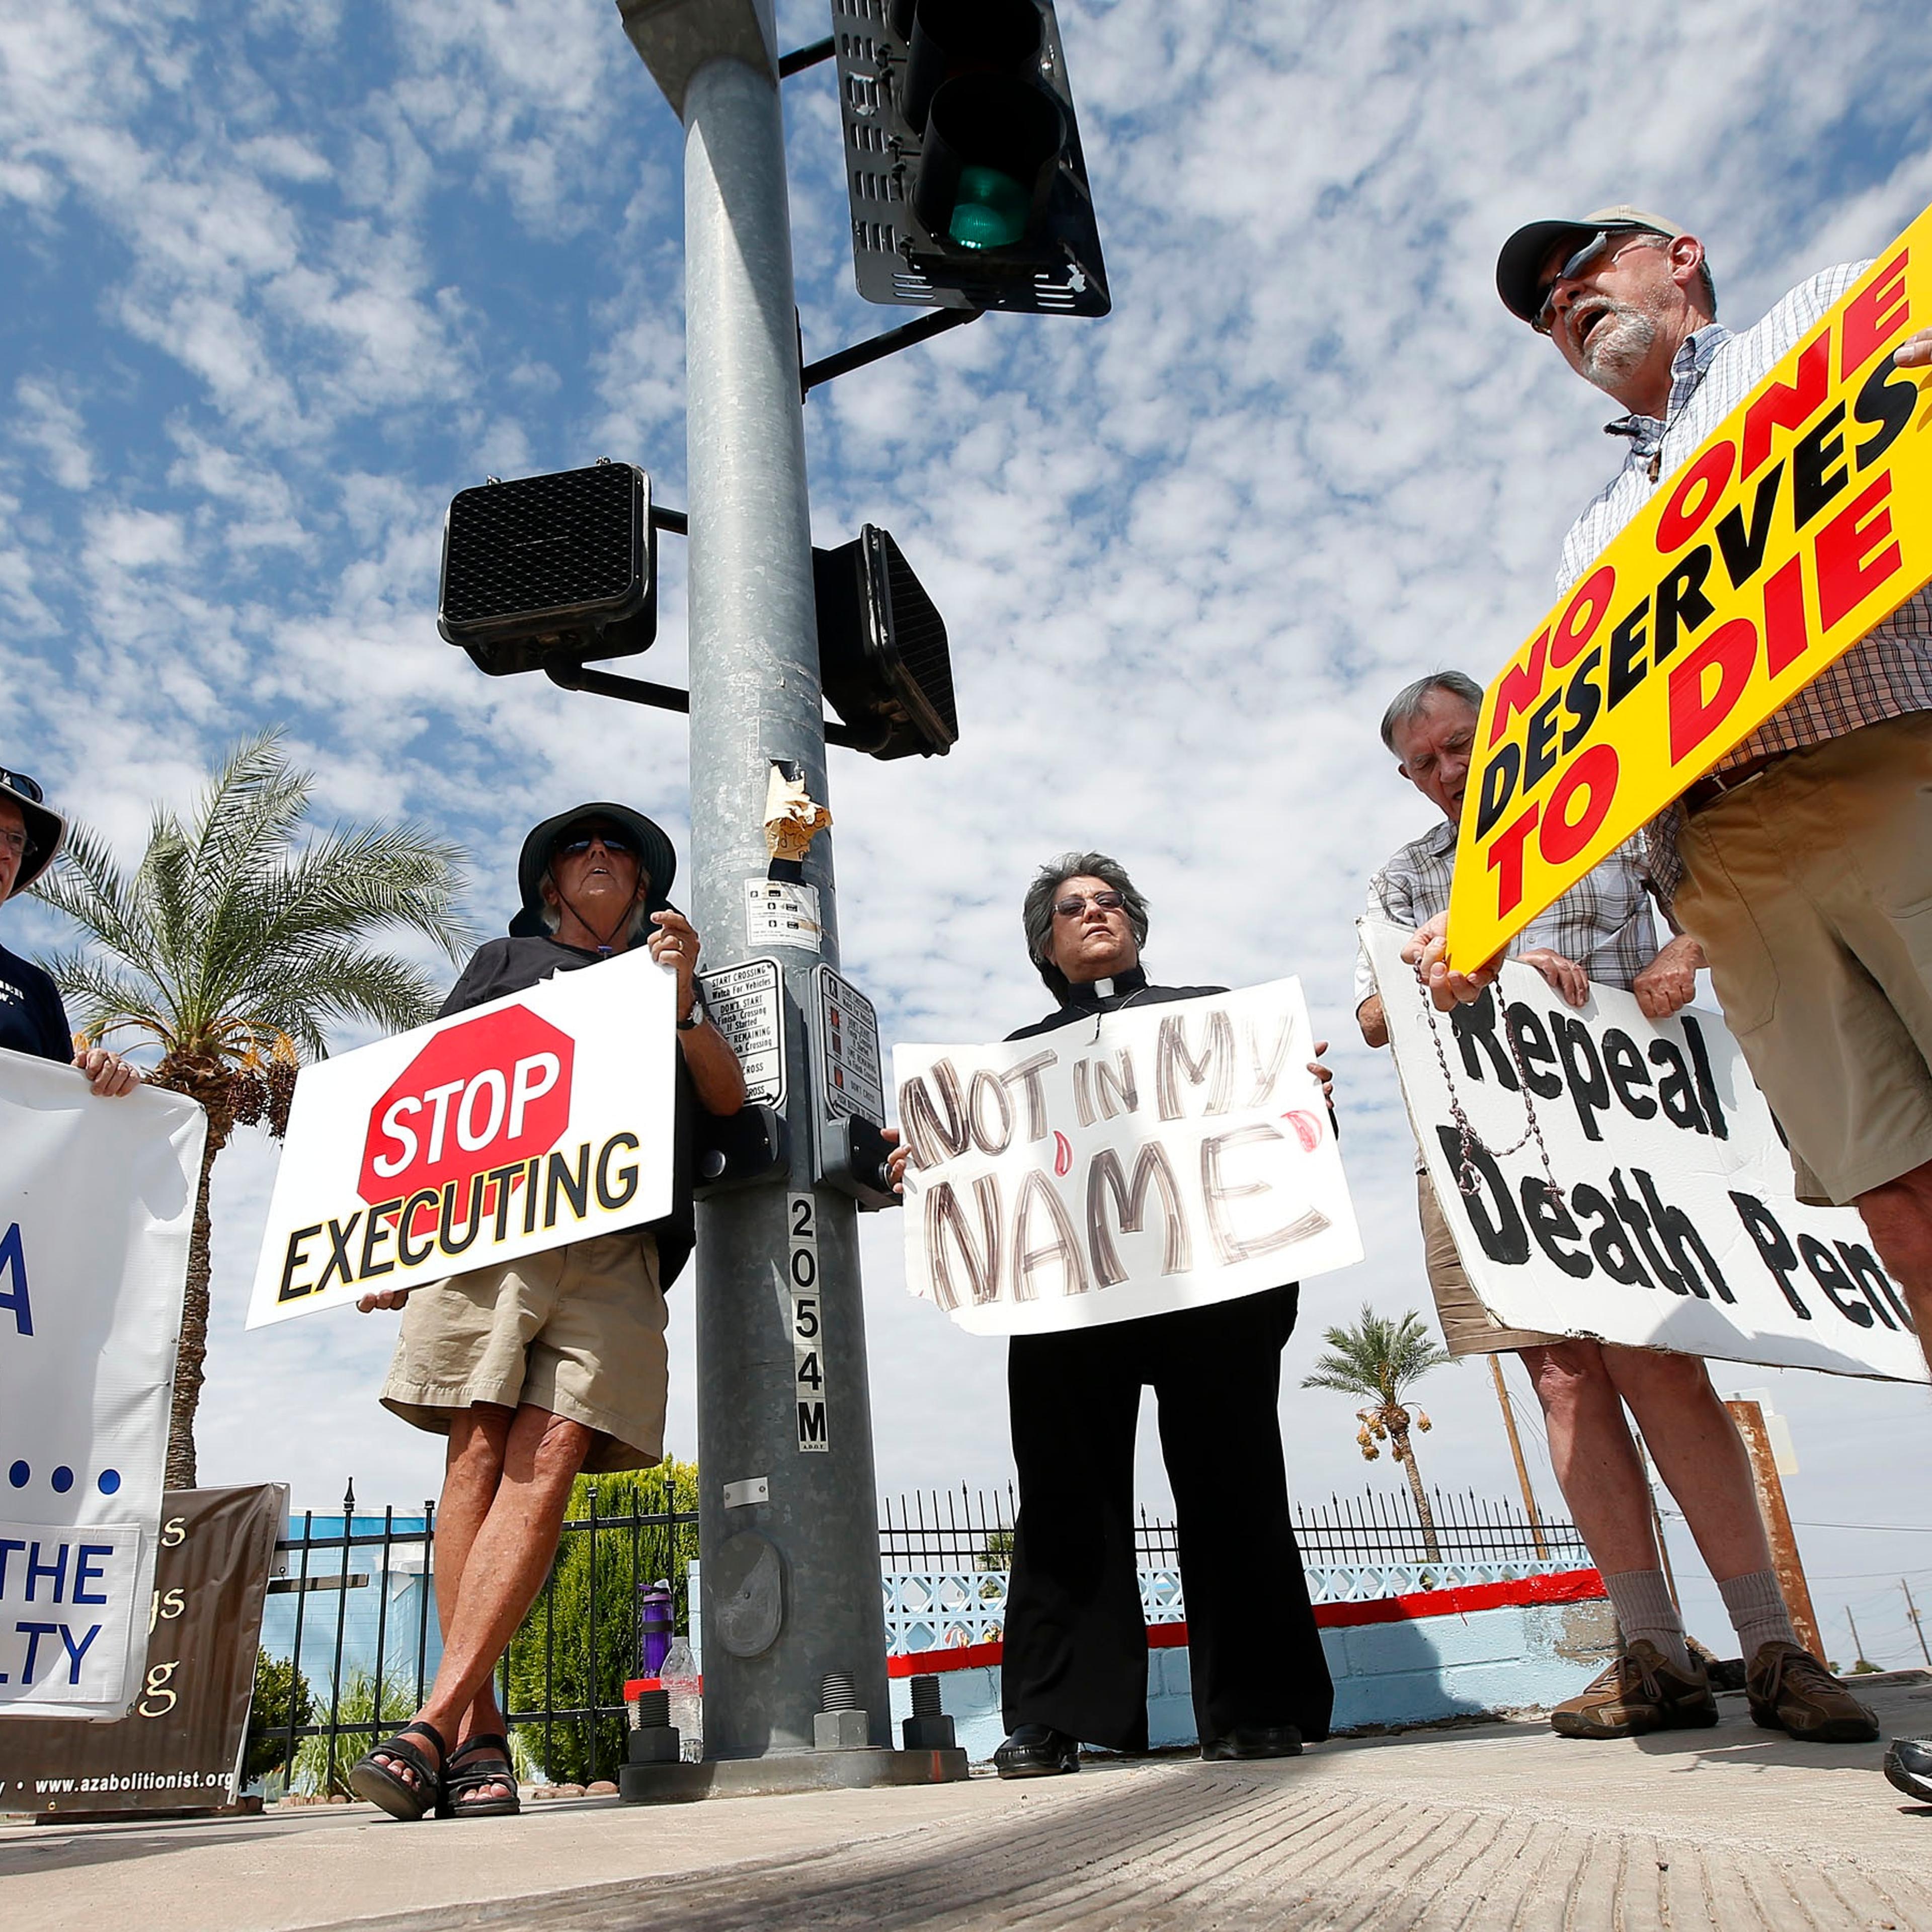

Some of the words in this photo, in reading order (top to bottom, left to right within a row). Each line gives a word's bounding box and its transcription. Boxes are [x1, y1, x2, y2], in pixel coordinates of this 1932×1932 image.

[1487, 565, 1616, 750] NO
[1655, 247, 1909, 553] ONE
[1475, 341, 1918, 843] DESERVES
[1487, 744, 1619, 920] TO
[1669, 468, 1902, 767] DIE
[712, 975, 731, 987] START
[733, 965, 766, 982] CROSSING
[712, 988, 730, 999] Watch
[733, 985, 743, 994] For
[746, 978, 771, 991] Vehicles
[735, 1016, 757, 1030] Started
[740, 1007, 766, 1019] Crossing
[743, 995, 762, 1007] START
[734, 1026, 771, 1043] REMAINING
[746, 1038, 772, 1051] Crossing
[1447, 985, 1729, 1142] Repeal
[372, 1052, 560, 1178] STOP
[899, 1049, 1059, 1171] NOT
[1073, 1045, 1138, 1127] IN
[1157, 1010, 1294, 1121] MY
[278, 1132, 640, 1304] EXECUTING
[923, 1123, 1332, 1313] NAME
[1436, 1124, 1737, 1304] Death
[0, 1621, 102, 1685] TY
[35, 1770, 234, 1794] www.azabolitionist.org
